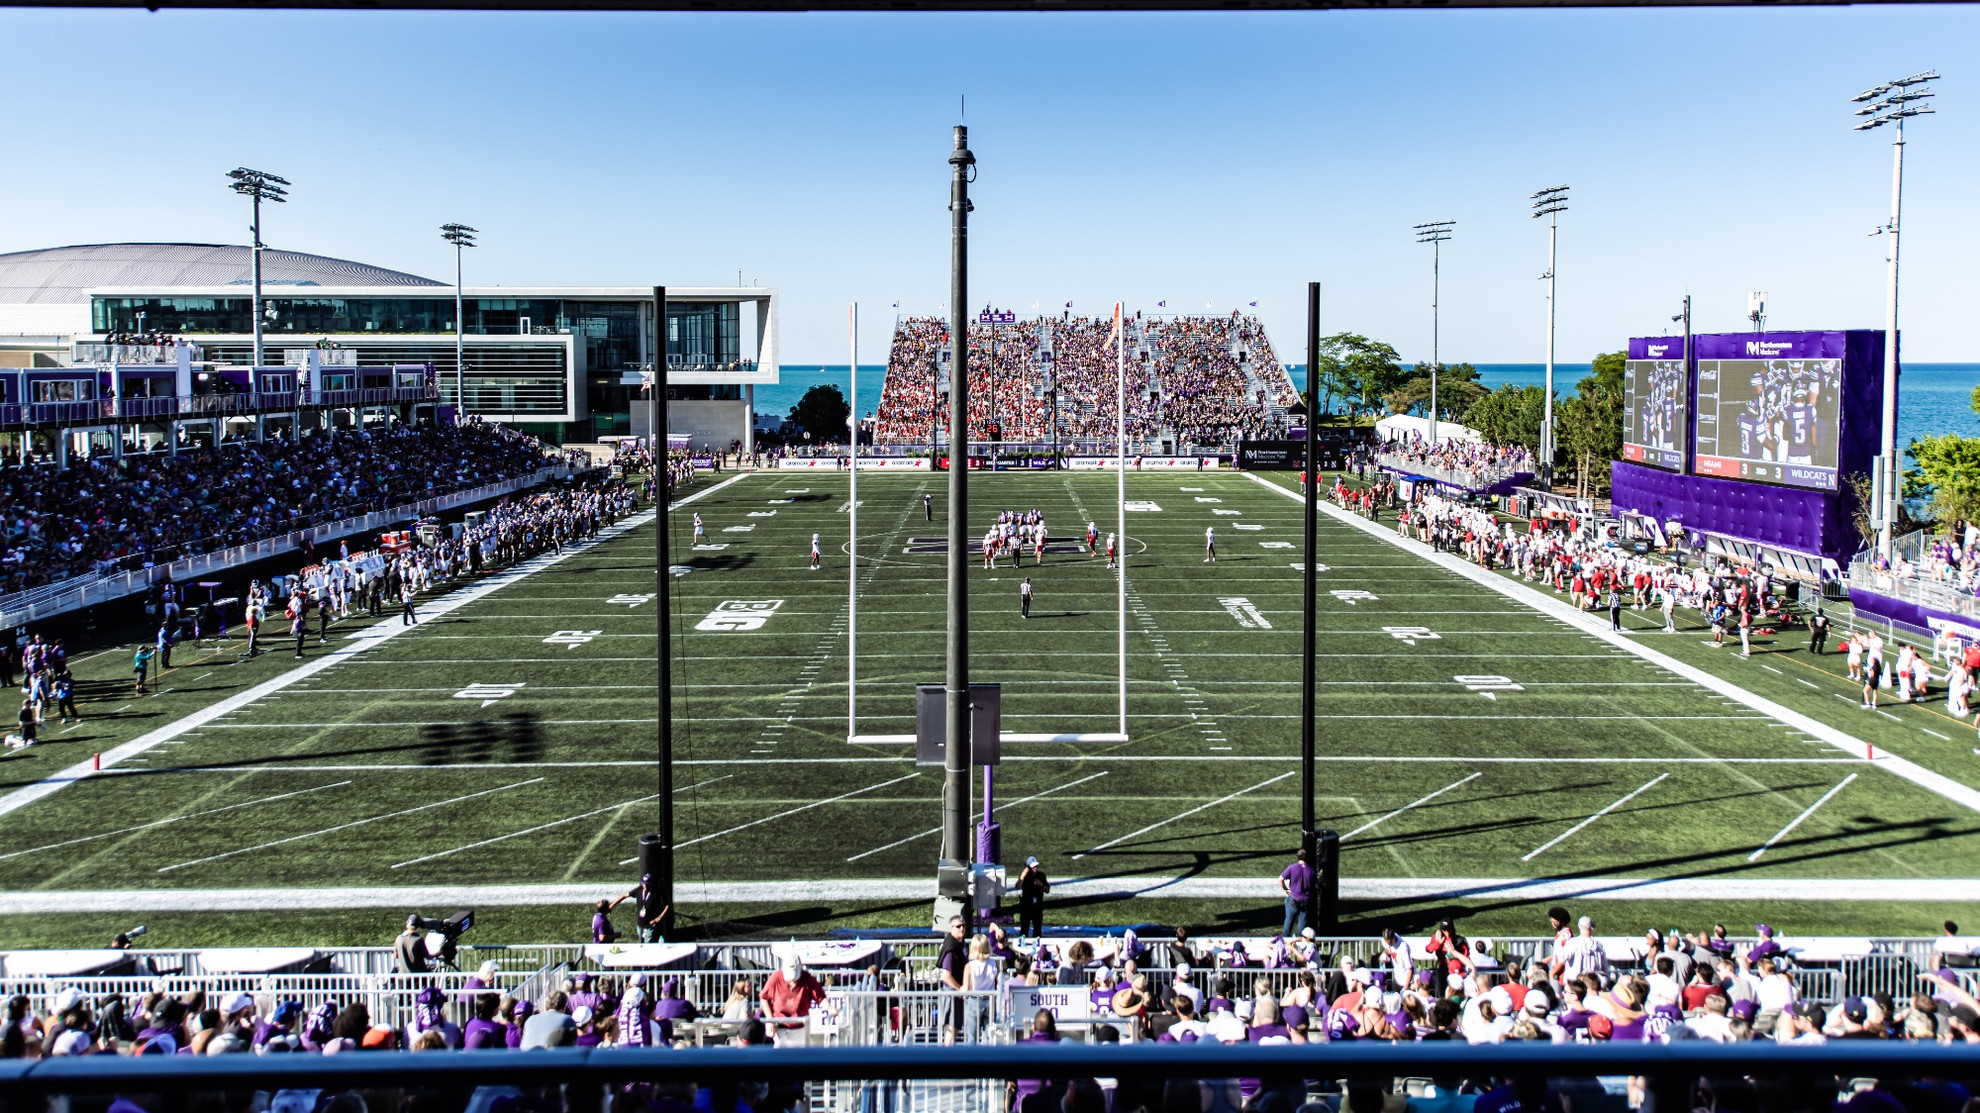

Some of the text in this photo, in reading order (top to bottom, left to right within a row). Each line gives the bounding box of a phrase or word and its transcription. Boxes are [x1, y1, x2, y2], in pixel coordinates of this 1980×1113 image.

[986, 424, 998, 433] 26
[1703, 459, 1722, 469] MIAMI
[1742, 463, 1748, 475] 3
[1774, 466, 1782, 479] 3
[1791, 468, 1827, 481] WILDCATS
[1030, 993, 1069, 1006] SOUTH
